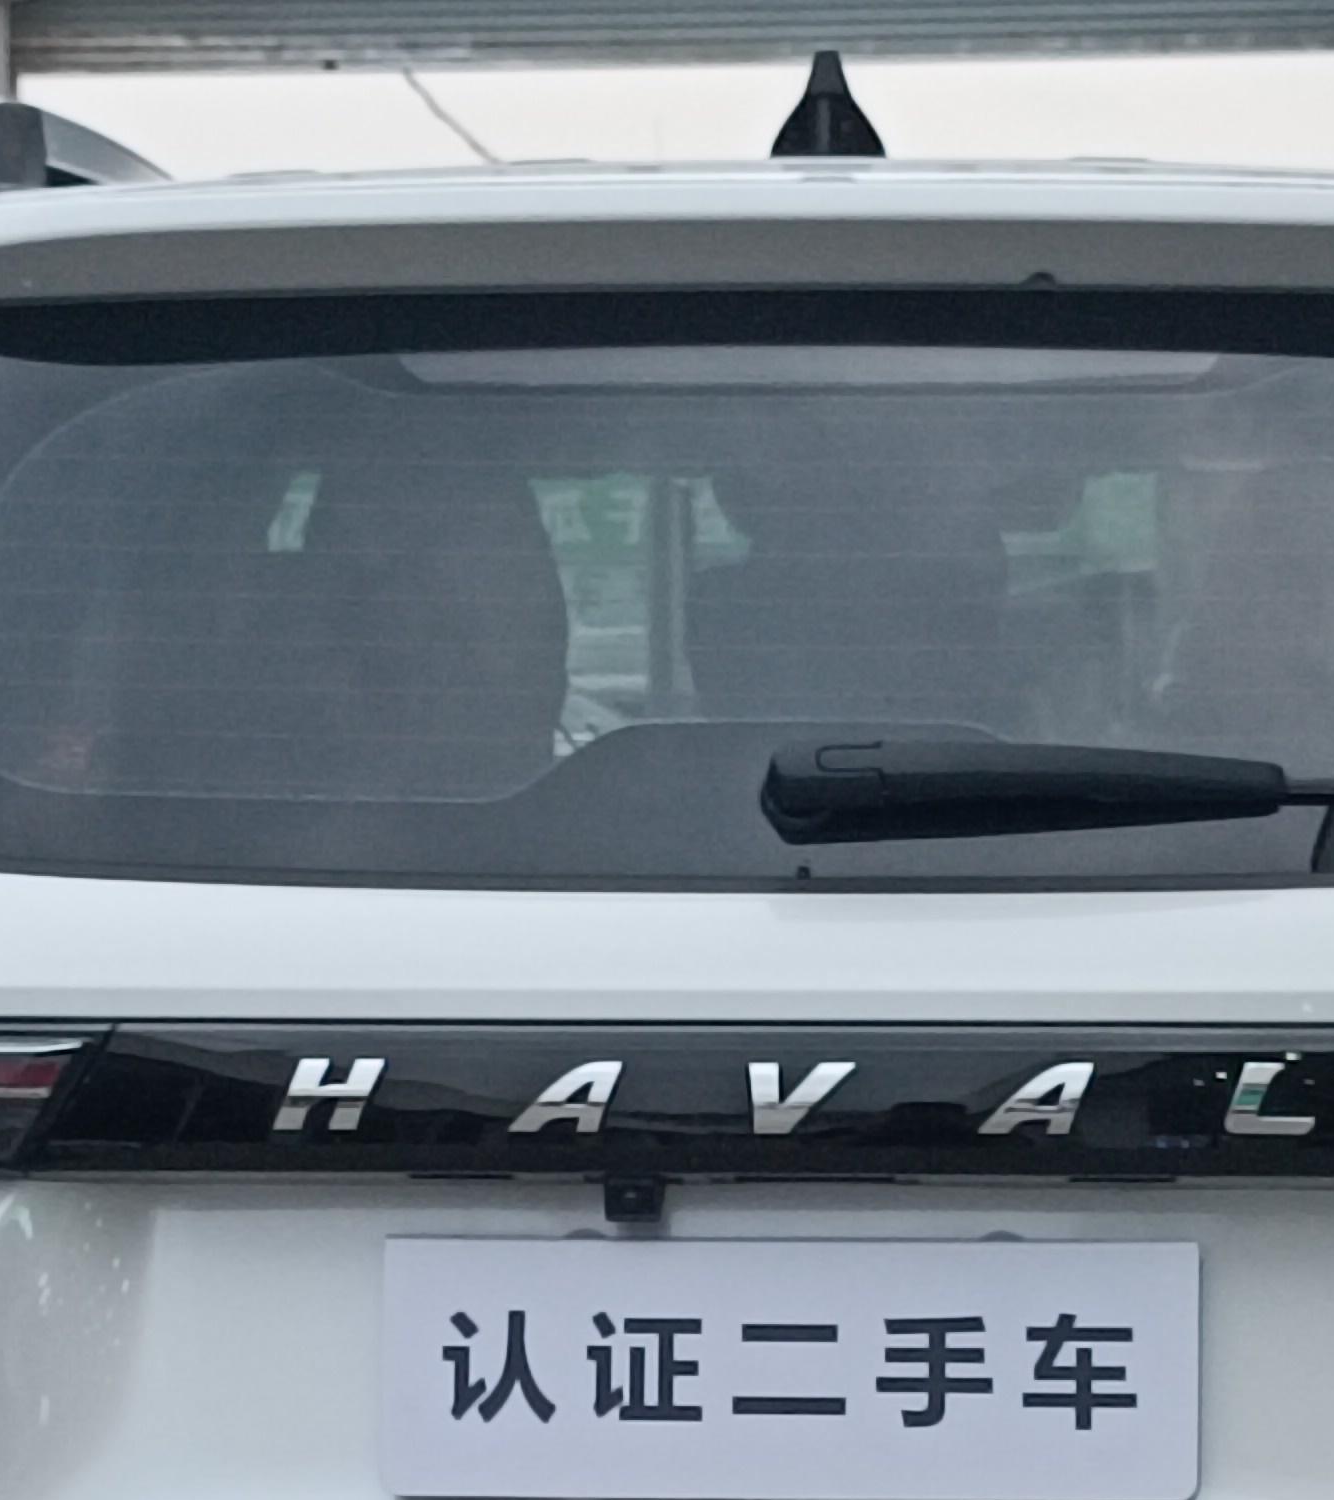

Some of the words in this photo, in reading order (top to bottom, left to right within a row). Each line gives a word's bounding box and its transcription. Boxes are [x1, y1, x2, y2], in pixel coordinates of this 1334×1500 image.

[272, 1056, 1317, 1136] HAVAL
[441, 1309, 1139, 1431] 认证二手车
